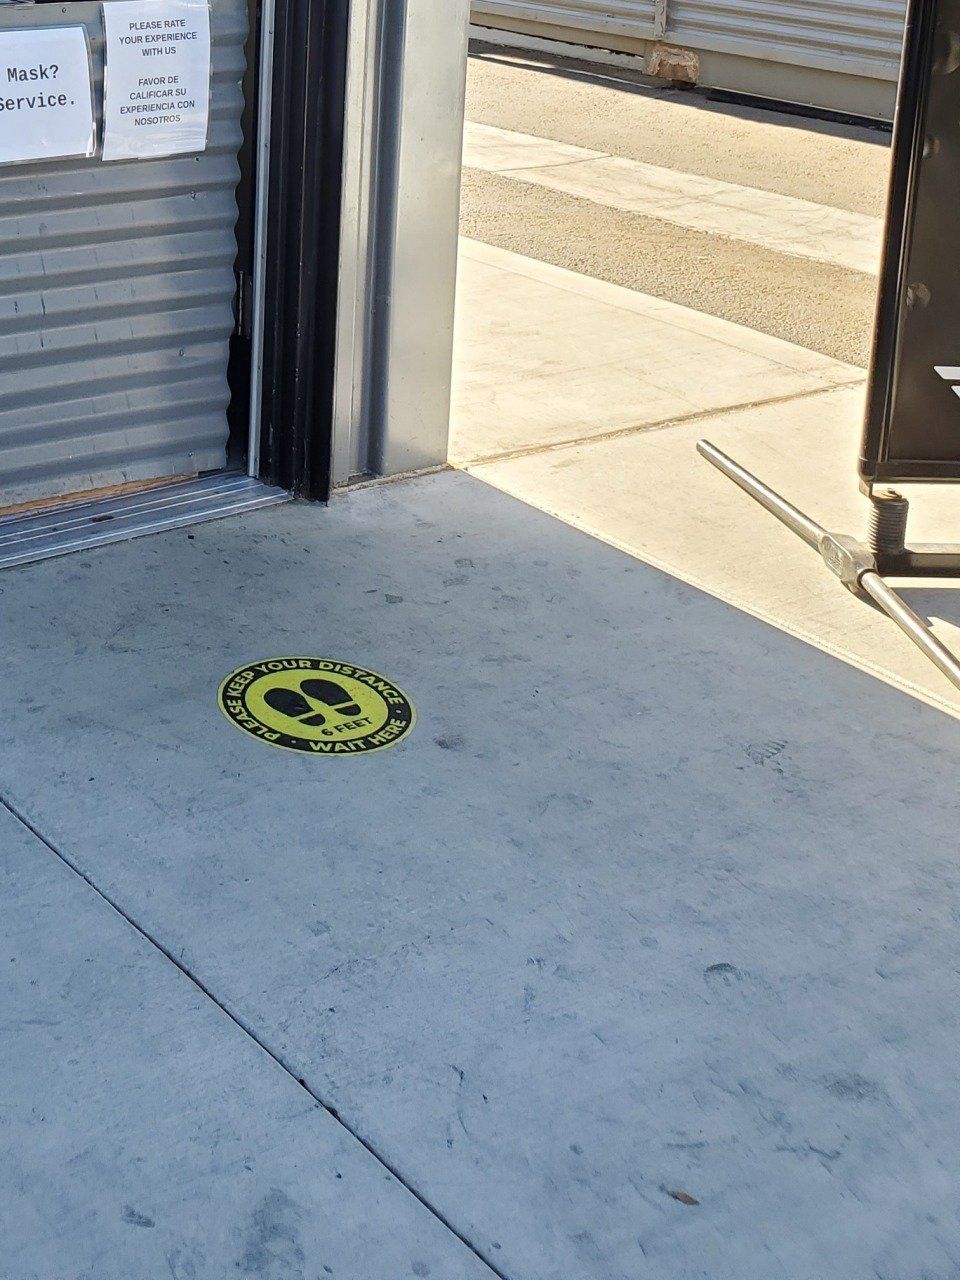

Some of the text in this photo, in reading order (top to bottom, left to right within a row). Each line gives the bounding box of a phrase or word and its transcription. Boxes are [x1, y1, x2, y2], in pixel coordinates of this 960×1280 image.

[129, 19, 186, 31] PLEASE RATE
[119, 31, 198, 45] YOUR EXPERIENCE
[141, 46, 177, 57] WITH US
[7, 64, 59, 83] Mask?
[138, 75, 179, 86] FAVOR DE
[129, 87, 187, 100] CALIFICAR SU
[120, 99, 196, 115] EXPERIENCIA CON
[134, 114, 182, 126] NOSOTROS
[227, 660, 404, 741] PLEASE KEEP YOUR DISTANCE
[321, 716, 373, 736] 6 FEET
[308, 718, 407, 753] WAIT HERE
